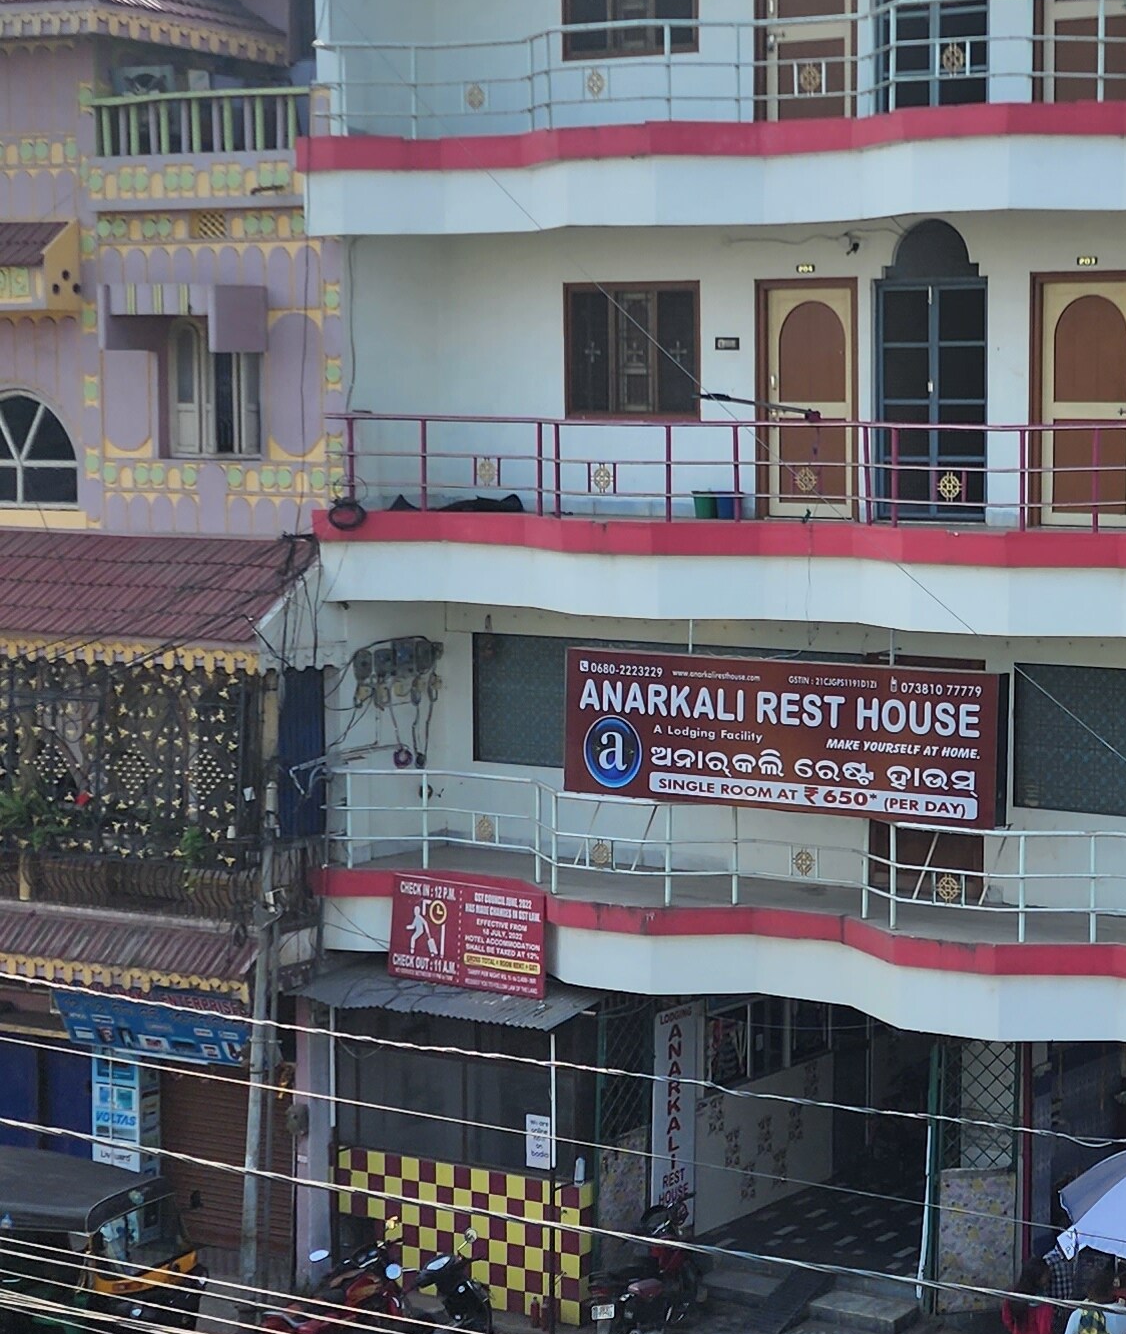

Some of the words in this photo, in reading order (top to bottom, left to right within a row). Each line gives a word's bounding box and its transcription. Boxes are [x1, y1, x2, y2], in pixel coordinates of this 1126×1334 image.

[591, 662, 663, 678] 0680-2223229
[672, 669, 761, 683] www.anarkaliresthouse.com
[788, 675, 810, 685] GSTIN
[901, 681, 943, 696] 073810
[946, 684, 982, 698] 77779
[579, 678, 744, 722] ANARKALI
[757, 690, 845, 729] REST
[856, 696, 981, 738] HOUSE
[653, 724, 663, 734] A
[667, 727, 716, 741] Lodging
[720, 730, 764, 744] Facility
[598, 731, 628, 771] a
[826, 738, 860, 751] MAKE
[863, 741, 921, 755] YOURSELF
[923, 745, 940, 757] AT
[941, 746, 981, 760] HOME.
[658, 777, 715, 794] SINGLE
[720, 783, 773, 798] ROOM
[776, 788, 799, 801] AT
[884, 797, 920, 812] (PER
[925, 800, 967, 818] DAY)
[400, 880, 422, 896] CHECK
[422, 883, 430, 897] IN
[434, 885, 443, 898] 12
[476, 918, 509, 930] EFFECTIVE
[509, 922, 528, 932] FROM
[464, 934, 485, 944] HOTEL
[392, 952, 415, 968] CHECK
[415, 956, 430, 971] OUT
[434, 959, 442, 973] 11
[496, 947, 516, 957] TAXED
[667, 1023, 682, 1169] ANARKALI
[96, 1109, 137, 1127] VOLTAS
[662, 1167, 686, 1188] REST
[658, 1181, 690, 1207] HOUSE
